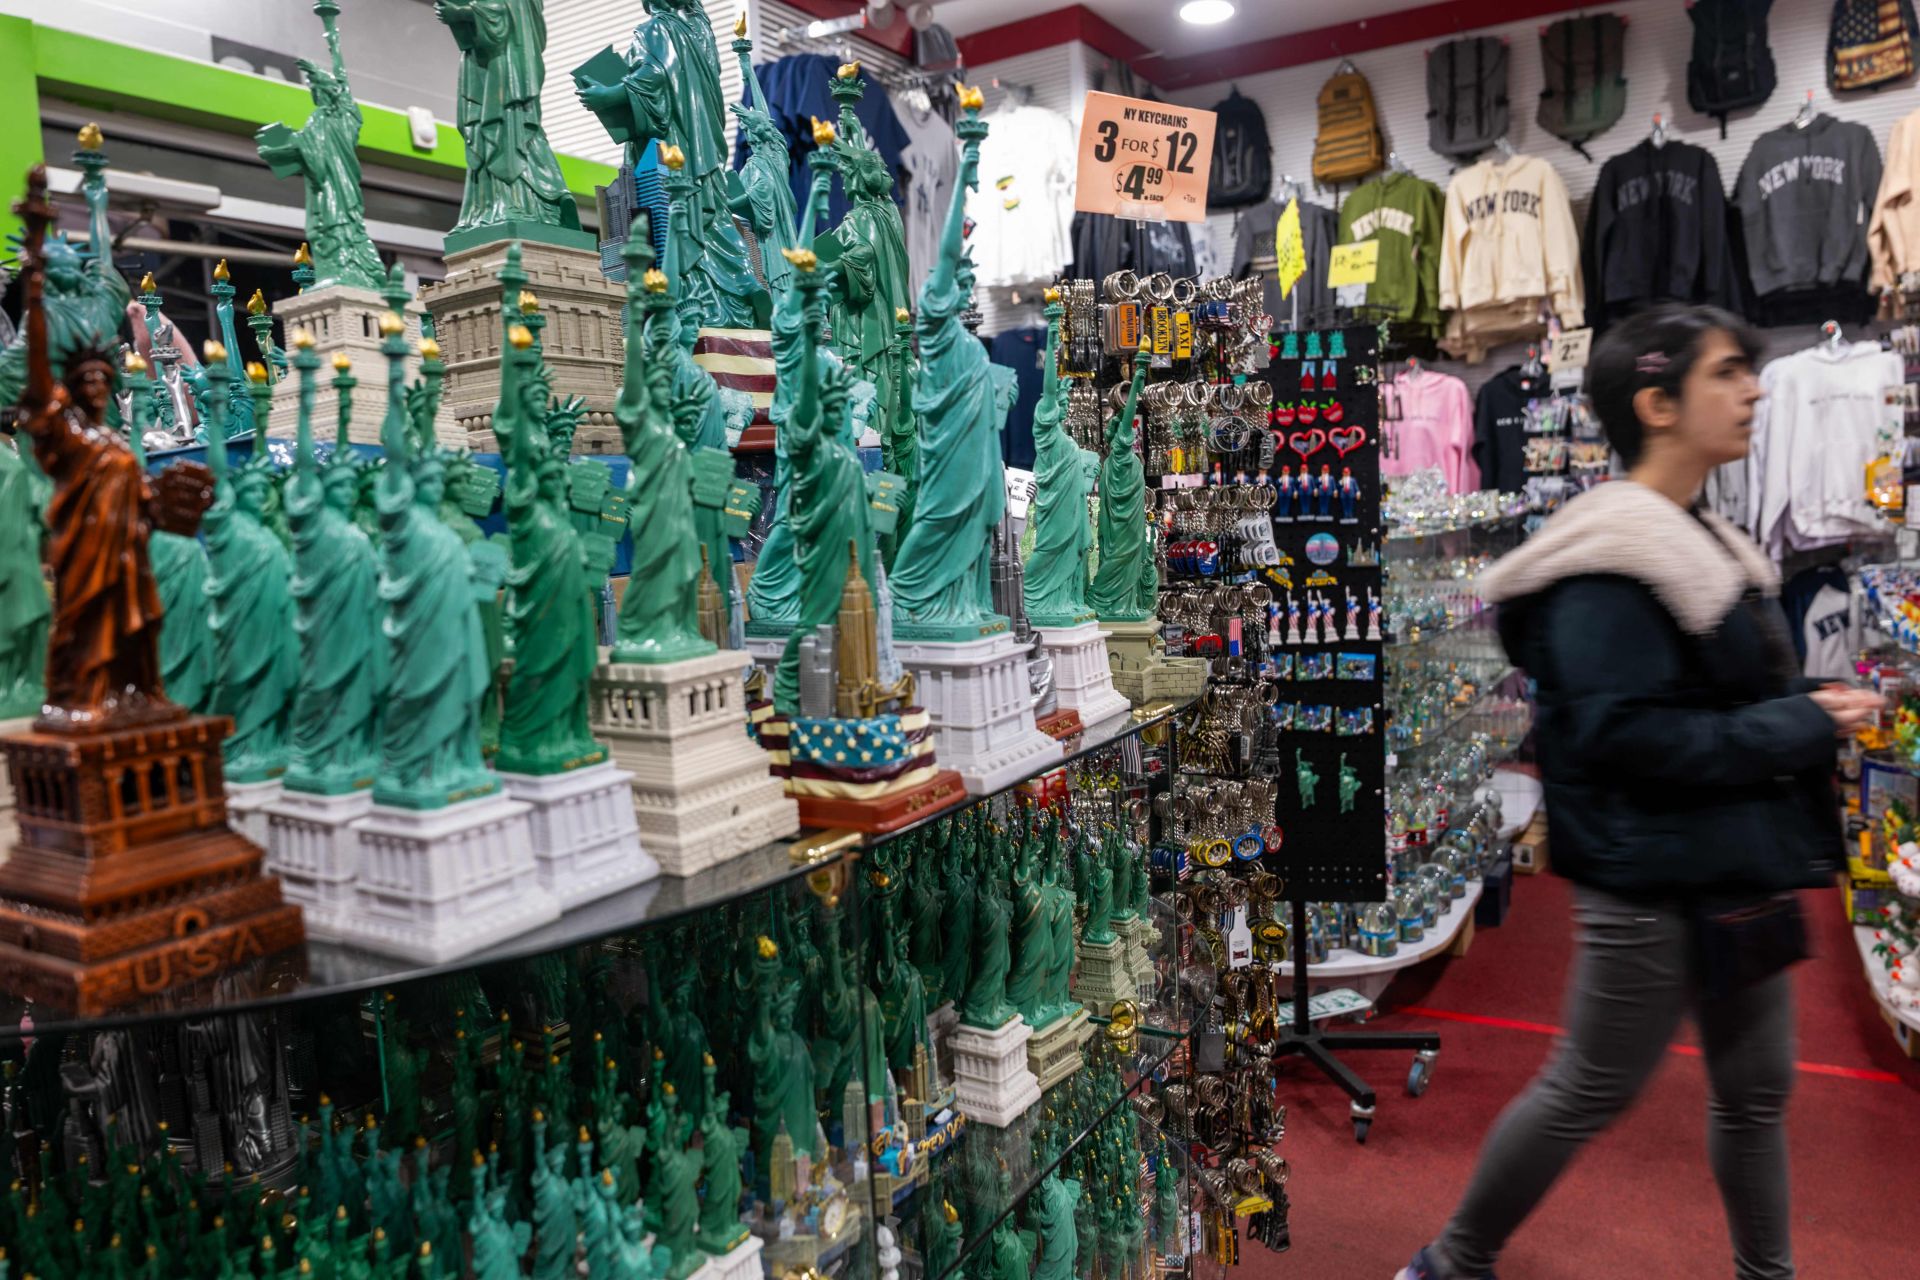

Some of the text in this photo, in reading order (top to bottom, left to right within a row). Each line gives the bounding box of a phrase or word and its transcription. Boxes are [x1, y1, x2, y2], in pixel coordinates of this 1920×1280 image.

[1124, 107, 1188, 129] NY KEYCHAINS
[1094, 120, 1119, 163] 3
[1121, 138, 1149, 154] FOR
[1759, 155, 1845, 200] NEW YORK
[1149, 194, 1164, 202] EACH
[1466, 189, 1541, 224] NEW YORK
[1125, 307, 1136, 344] CHINATOWN
[1156, 309, 1169, 354] BROOKLYN
[1179, 320, 1190, 350] TAXI
[136, 925, 263, 993] USA
